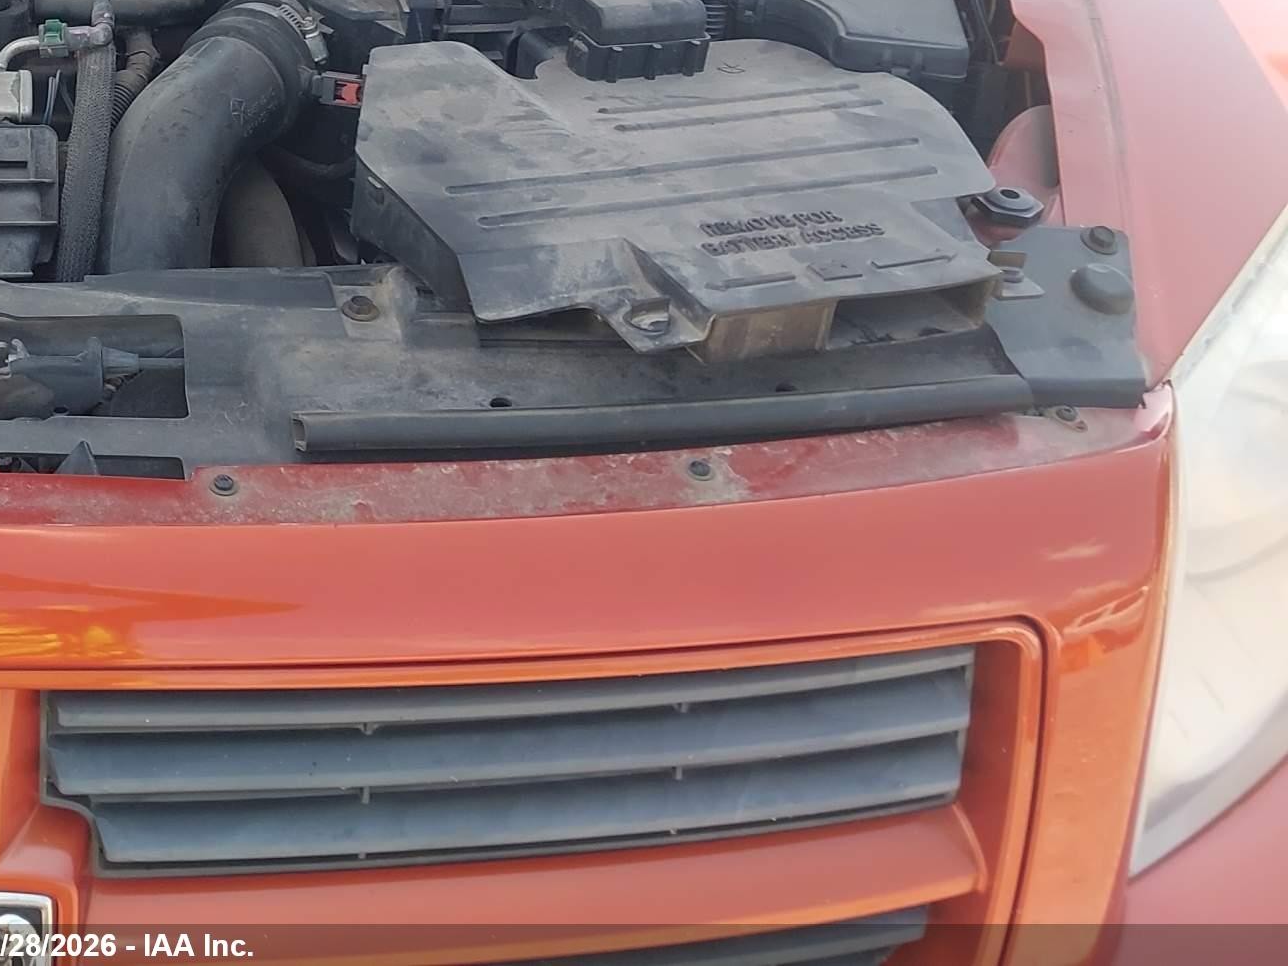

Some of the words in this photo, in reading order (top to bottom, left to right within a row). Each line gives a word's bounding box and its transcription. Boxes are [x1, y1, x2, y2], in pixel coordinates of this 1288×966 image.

[699, 214, 795, 237] REMOVE
[793, 210, 843, 226] FOR
[700, 234, 797, 256] BATTERY
[800, 223, 885, 245] ACCESS
